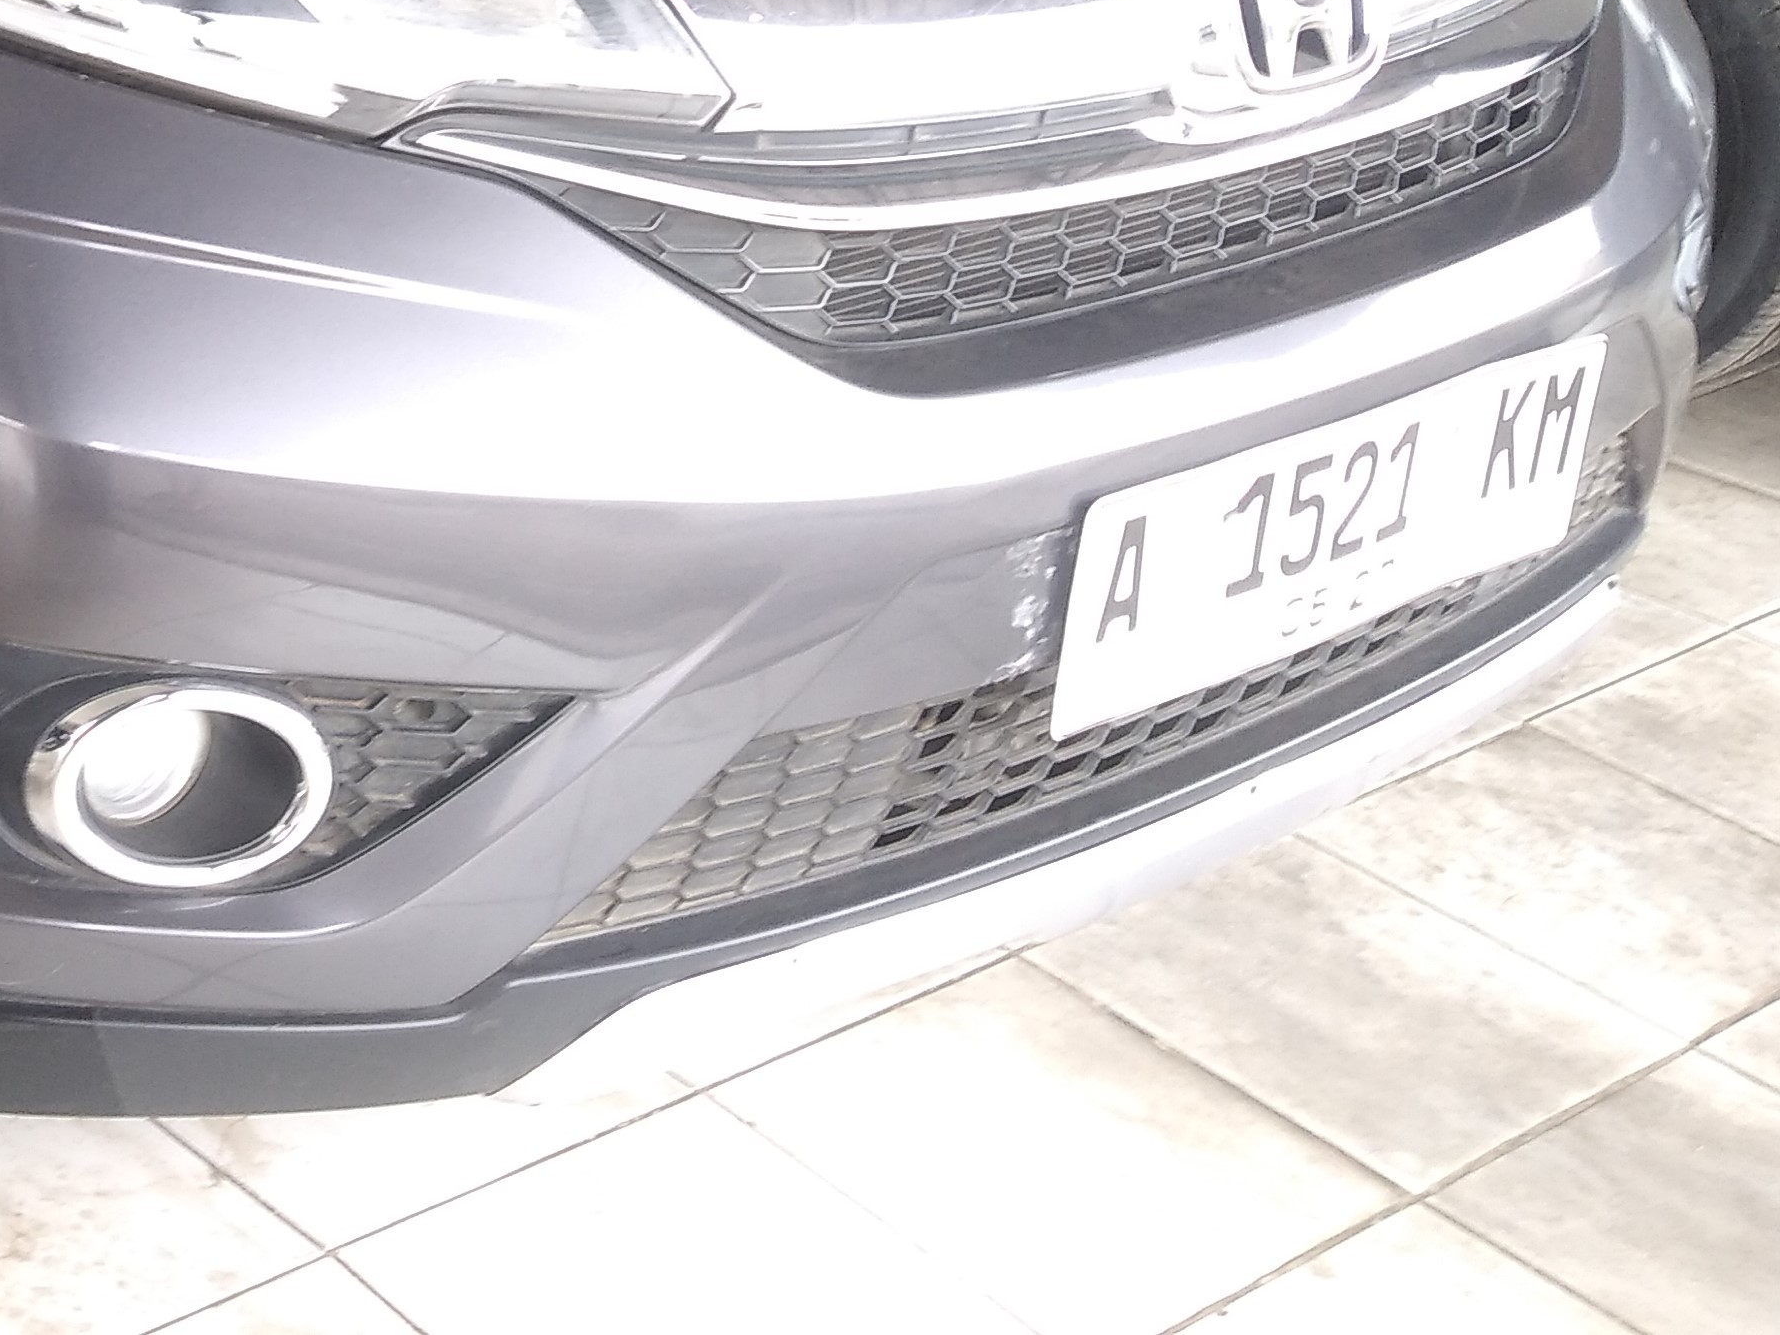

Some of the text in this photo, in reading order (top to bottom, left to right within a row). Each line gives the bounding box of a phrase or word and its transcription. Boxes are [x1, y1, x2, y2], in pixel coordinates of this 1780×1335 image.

[1095, 366, 1586, 643] A 1521 KM
